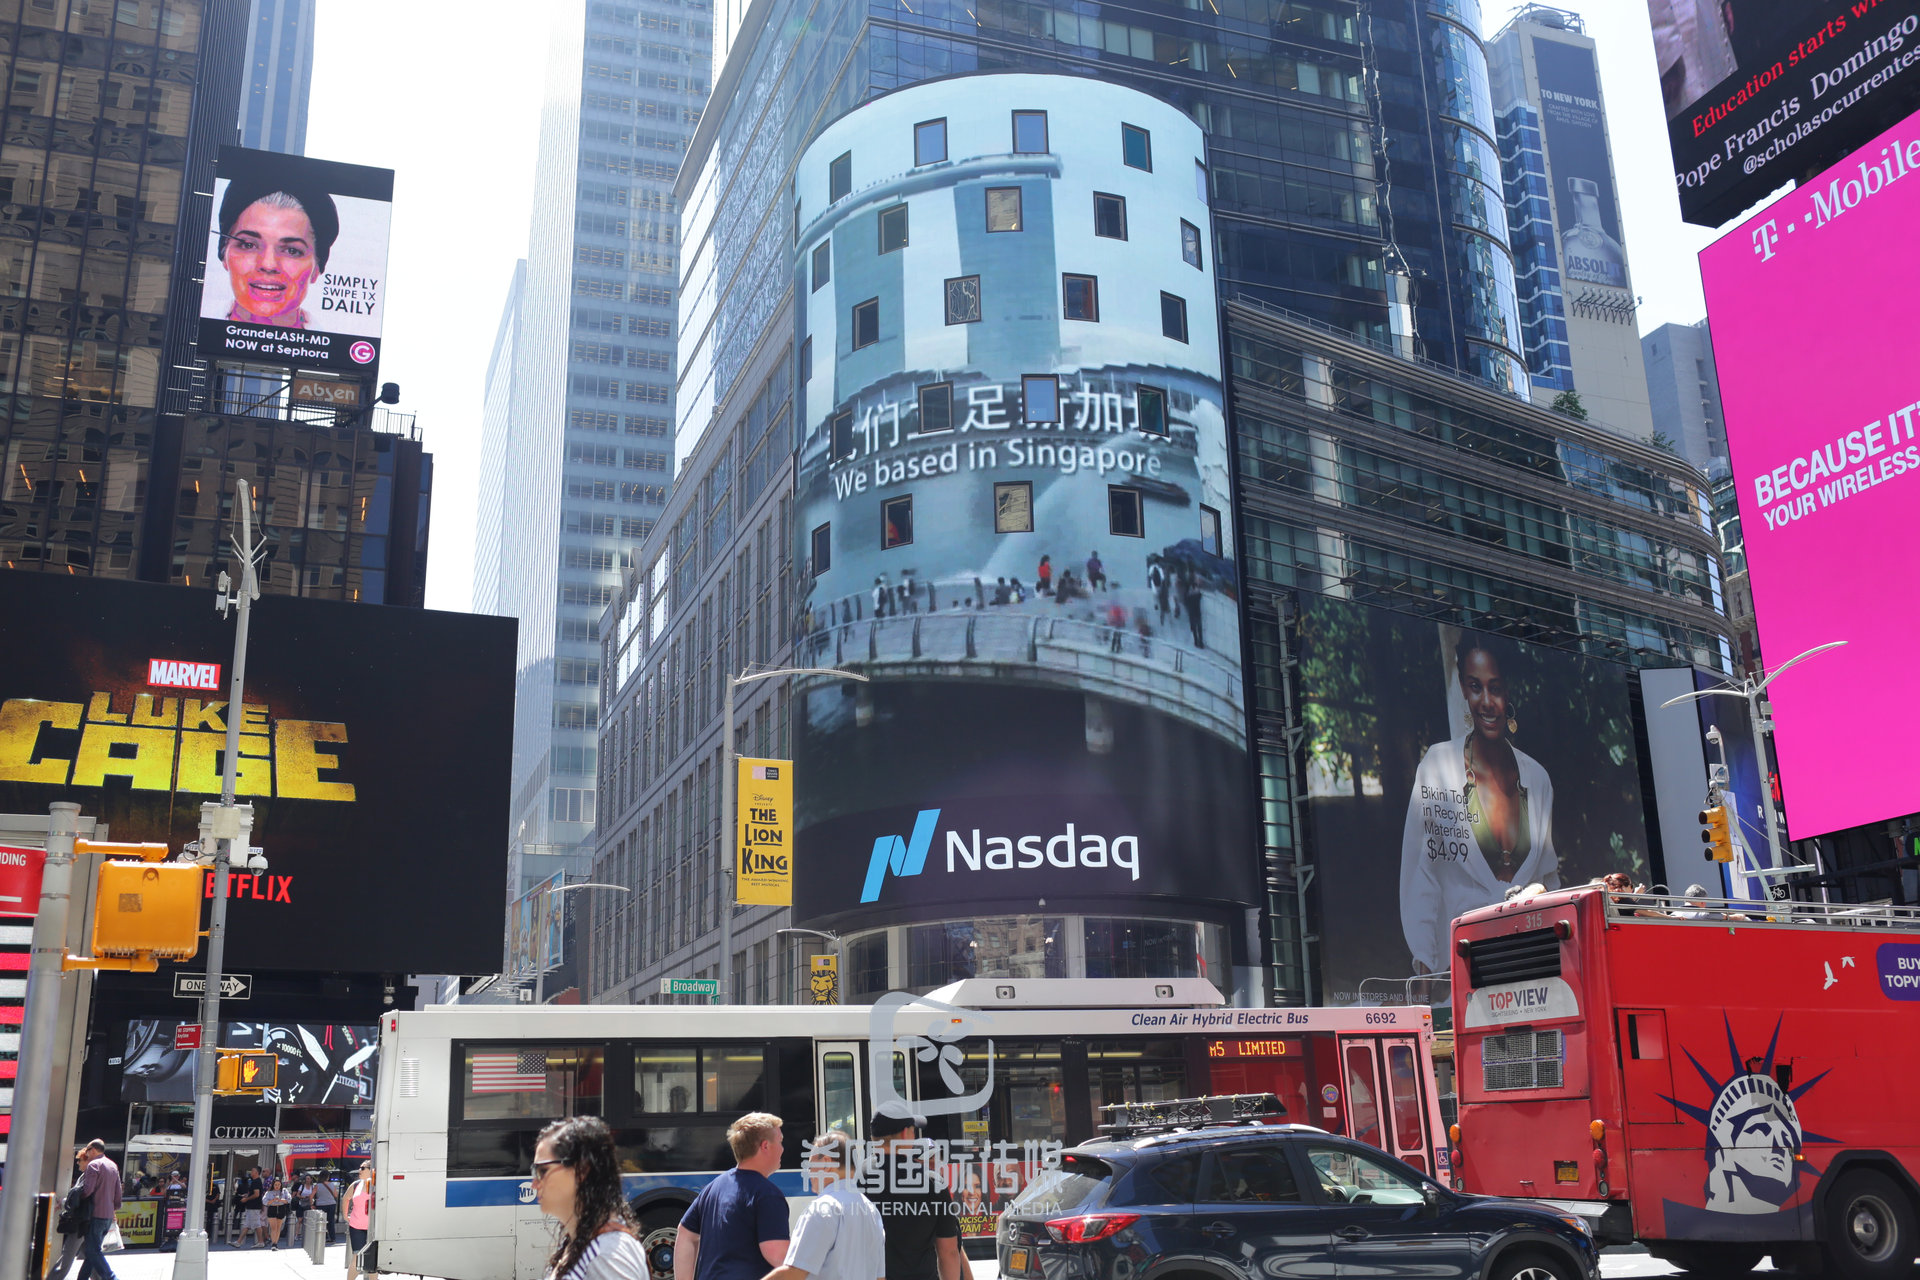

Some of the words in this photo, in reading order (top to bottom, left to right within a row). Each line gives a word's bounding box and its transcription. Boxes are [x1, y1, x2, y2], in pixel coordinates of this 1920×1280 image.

[1692, 61, 1784, 138] Education
[1788, 15, 1847, 67] starts
[1541, 88, 1553, 100] TO
[1553, 91, 1573, 104] NEW
[1724, 96, 1801, 161] Francis
[1810, 15, 1918, 100] Domingo
[1743, 44, 1920, 175] @scholasocurrentes
[1567, 255, 1621, 277] ABSOL
[323, 273, 379, 291] SIMPLY
[322, 286, 358, 299] SWIPE
[362, 291, 377, 301] 1X
[321, 297, 376, 316] DAILY
[225, 325, 331, 346] GrandeLASH-MD
[225, 338, 258, 351] NOW
[260, 343, 275, 353] at
[276, 344, 330, 360] Sephora
[298, 382, 355, 402] Absen
[834, 468, 867, 502] We
[875, 443, 958, 488] based
[968, 440, 997, 471] in
[1008, 438, 1162, 477] Singapore
[1754, 419, 1886, 508] BECAUSE
[1762, 492, 1817, 532] YOUR
[1817, 445, 1920, 508] WIRELESS
[149, 660, 218, 689] MARVEL
[88, 691, 270, 735] LUKE
[0, 698, 357, 802] CAGE
[1420, 785, 1448, 802] Bikini
[1451, 789, 1469, 806] Top
[749, 807, 776, 821] THE
[1422, 805, 1433, 817] in
[1434, 806, 1480, 825] Recycled
[744, 823, 783, 847] LION
[1424, 821, 1470, 840] Materials
[0, 852, 27, 867] DING
[945, 822, 1140, 882] Nasdaq
[1426, 837, 1469, 863] $4.99
[741, 847, 788, 875] KING
[204, 872, 293, 904] ETFLIX
[1525, 914, 1543, 929] 315
[1897, 957, 1920, 970] BUY
[186, 980, 206, 991] ONE
[219, 981, 240, 992] WAY
[673, 980, 716, 995] Broadway
[1884, 974, 1920, 988] TOPV
[1333, 991, 1351, 1001] NOW
[1352, 992, 1360, 1001] IN
[1361, 992, 1388, 1001] STORES
[1389, 993, 1403, 1002] AND
[1487, 986, 1549, 1011] TOPVIEW
[1131, 1013, 1168, 1026] Clean
[1169, 1013, 1189, 1025] Air
[1191, 1012, 1235, 1027] Hybrid
[1236, 1011, 1284, 1026] Electric
[1286, 1012, 1309, 1025] Bus
[1365, 1012, 1397, 1025] 6692
[1238, 1040, 1286, 1056] LIMITED
[215, 1126, 278, 1139] CITIZEN
[519, 1186, 534, 1198] MTA
[117, 1212, 154, 1229] utiful
[958, 1215, 988, 1224] ANCISCA
